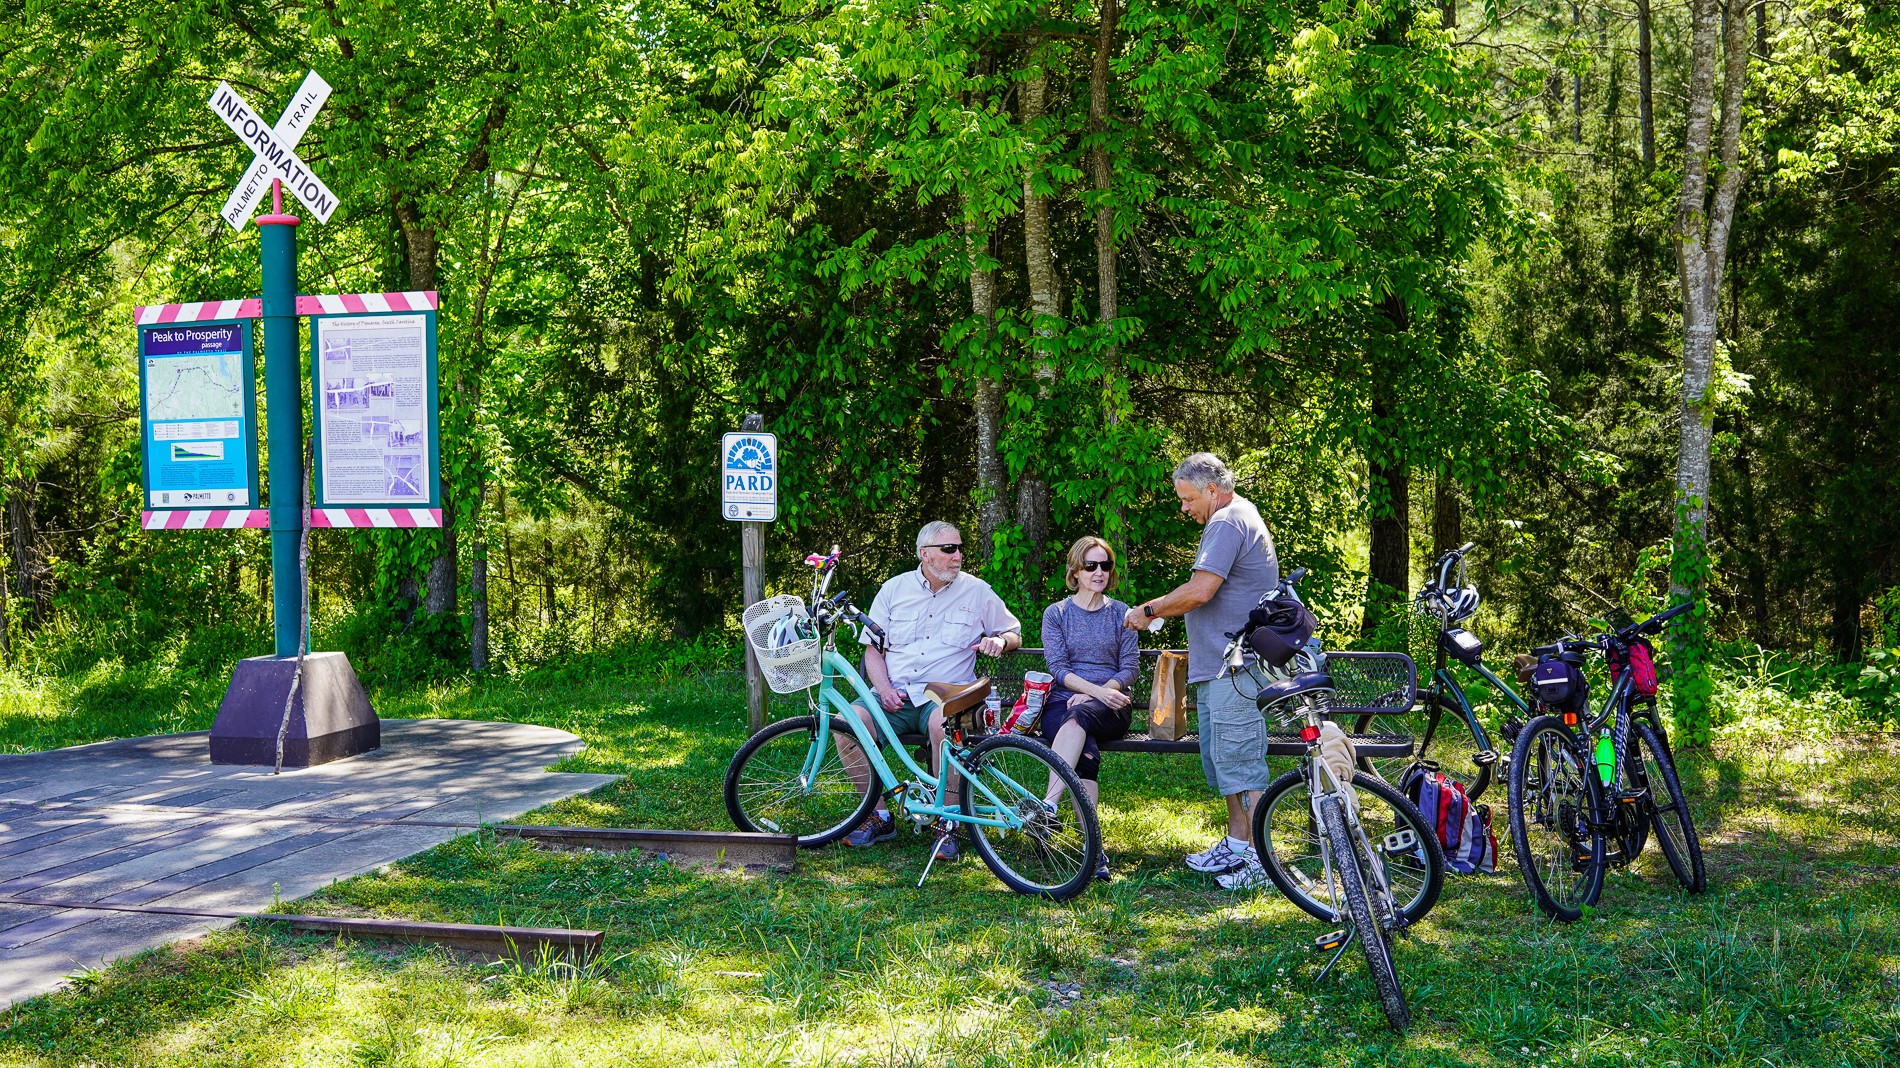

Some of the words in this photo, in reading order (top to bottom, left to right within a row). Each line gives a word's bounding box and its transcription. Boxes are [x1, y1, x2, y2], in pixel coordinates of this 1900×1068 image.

[216, 91, 332, 216] INFORMATION
[228, 164, 268, 223] PALMETTO
[288, 92, 318, 129] TRAIL
[152, 330, 174, 343] Peak
[175, 332, 184, 341] to
[186, 328, 232, 342] Prosperity
[201, 341, 222, 349] passage
[726, 474, 773, 491] PARD
